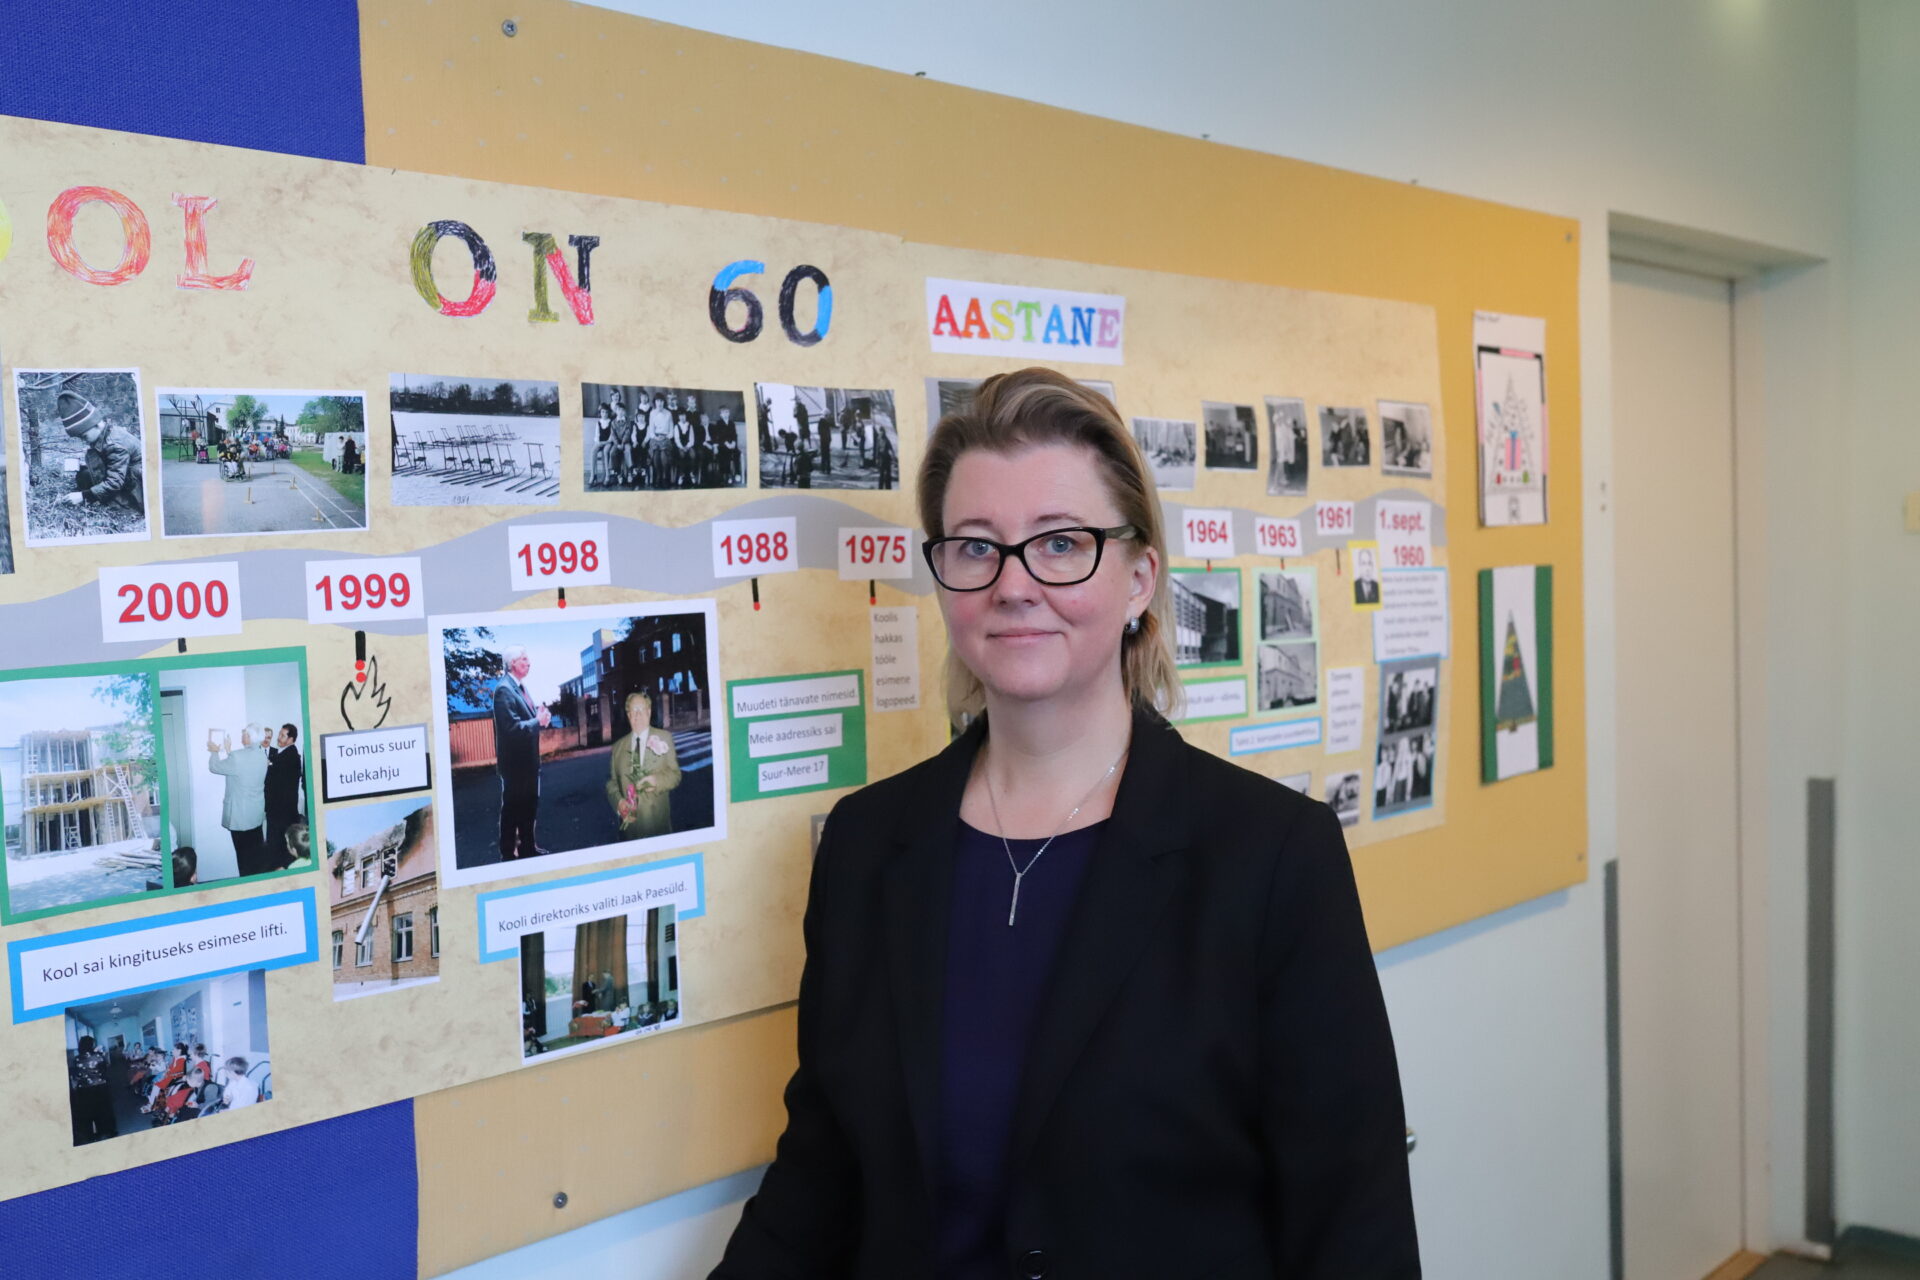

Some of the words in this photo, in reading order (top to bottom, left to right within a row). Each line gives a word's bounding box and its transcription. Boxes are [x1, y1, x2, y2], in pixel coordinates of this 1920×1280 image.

[0, 186, 255, 290] OL
[410, 220, 600, 326] ON
[709, 260, 833, 347] 60
[933, 295, 1120, 348] AASTANE
[1316, 506, 1352, 528] 1961
[1380, 508, 1425, 533] 1.sept.
[1186, 520, 1228, 543] 1964
[1258, 524, 1297, 547] 1963
[517, 540, 599, 577] 1998
[720, 531, 789, 566] 1988
[845, 535, 906, 564] 1975
[1393, 546, 1425, 566] 1960
[118, 579, 229, 623] 2000
[315, 572, 411, 612] 1999
[737, 699, 777, 713] Muudeti
[779, 694, 819, 708] tänavate
[821, 688, 858, 702] nimesid.
[749, 733, 774, 745] Meie
[776, 726, 822, 742] aadressiks
[824, 724, 837, 735] sai
[337, 742, 385, 758] Toimus
[388, 738, 417, 752] suur
[339, 766, 401, 785] tulekahju
[762, 765, 811, 781] Suur-Mere
[814, 761, 824, 772] 17
[498, 914, 527, 932] Kooli
[530, 902, 590, 925] direktoriks
[592, 895, 618, 912] valiti
[621, 890, 643, 906] Jaak
[645, 881, 688, 900] Paesüld.
[43, 962, 79, 983] Kool
[83, 957, 105, 974] sai
[108, 941, 194, 972] kingituseks
[197, 931, 257, 953] esimese
[260, 922, 288, 945] lifti.
